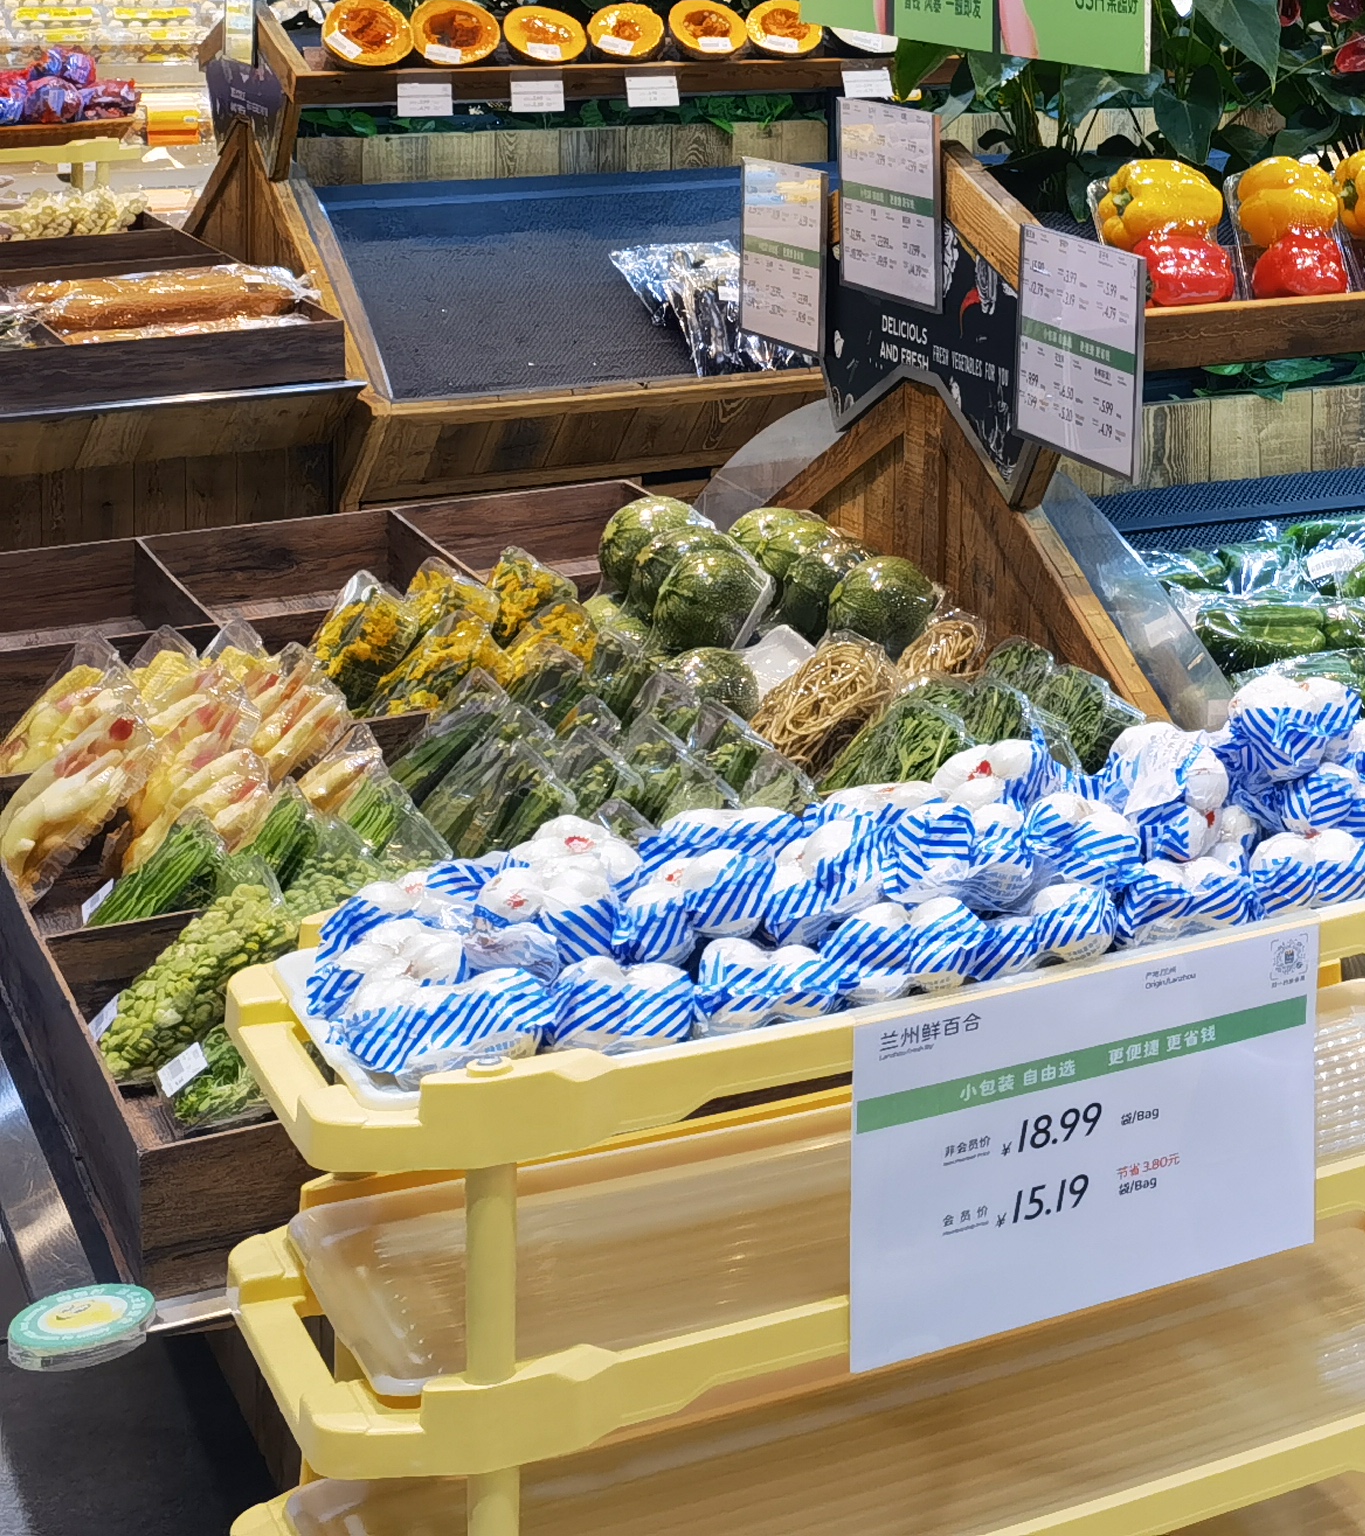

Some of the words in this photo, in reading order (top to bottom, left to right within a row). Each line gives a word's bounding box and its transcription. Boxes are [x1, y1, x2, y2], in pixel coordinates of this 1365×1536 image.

[879, 341, 899, 363] AND
[932, 344, 949, 366] FRESH
[879, 1012, 982, 1052] 兰州鲜百合
[959, 1074, 1016, 1102] 小包装
[1022, 1059, 1077, 1087] 自由选
[1107, 1039, 1160, 1066] 更便捷
[1166, 1024, 1217, 1052] 更省钱
[944, 1135, 991, 1158] 非会员价
